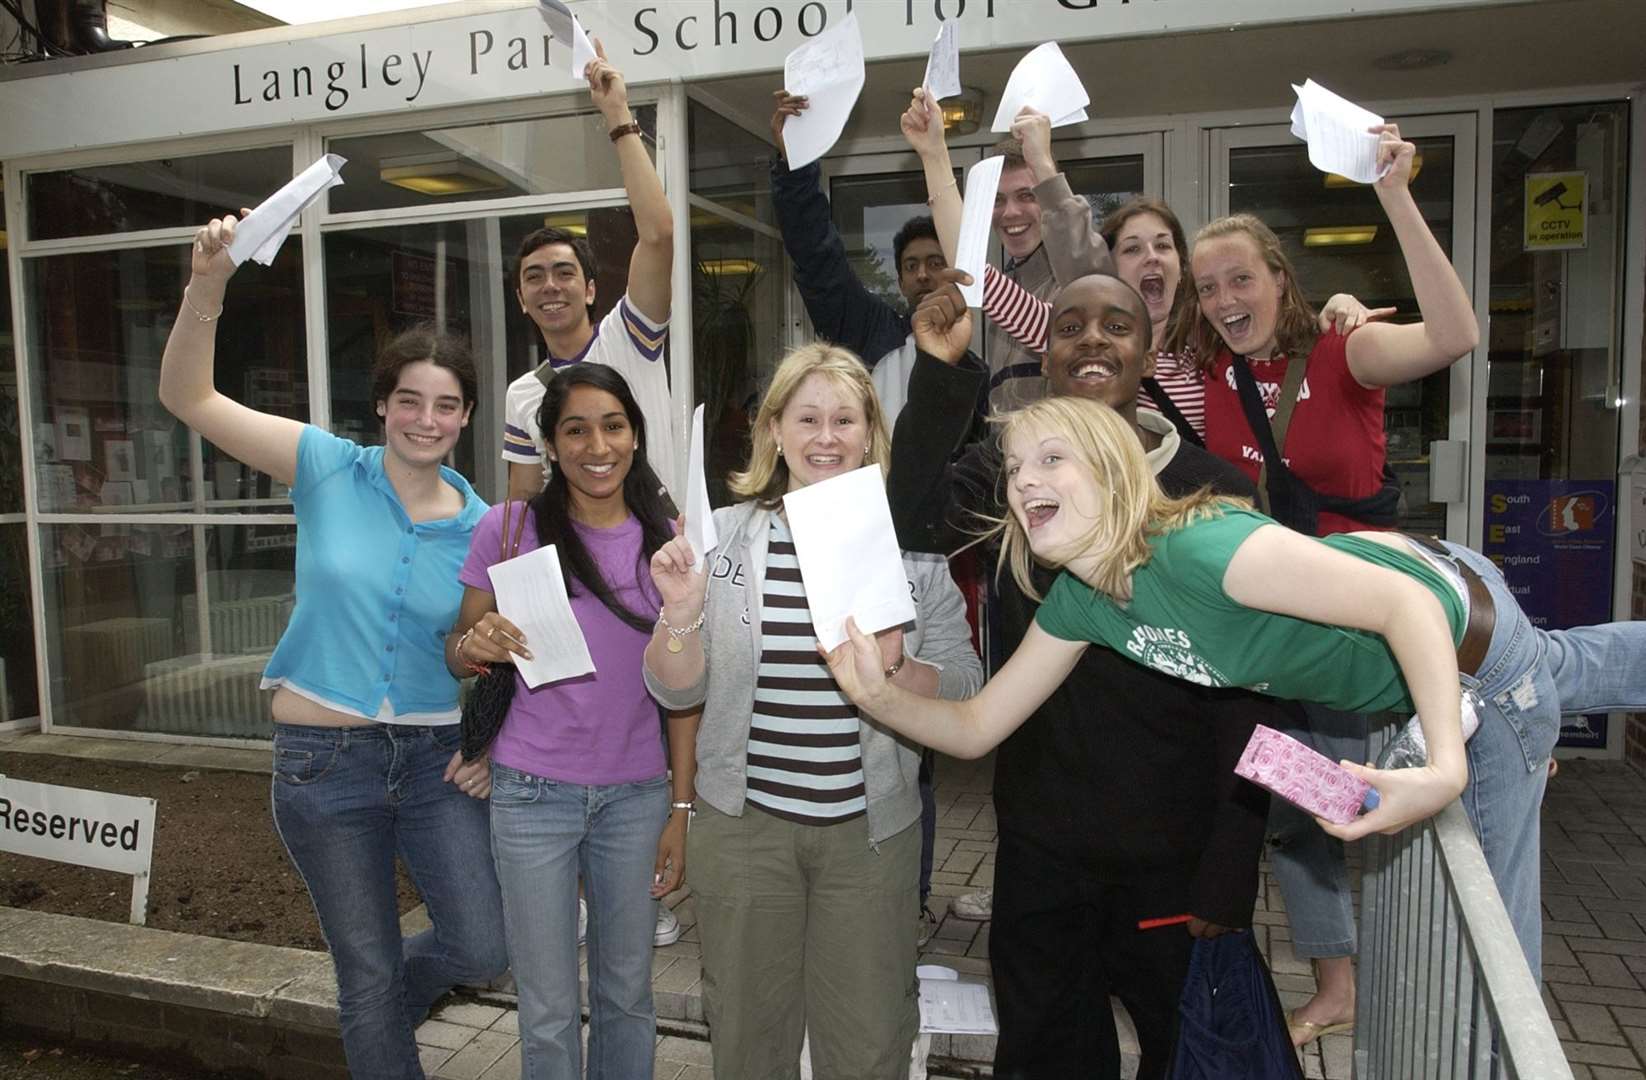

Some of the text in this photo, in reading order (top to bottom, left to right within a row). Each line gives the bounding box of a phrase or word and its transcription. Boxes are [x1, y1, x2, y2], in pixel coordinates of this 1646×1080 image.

[233, 43, 433, 111] Langley
[469, 14, 590, 75] Par
[1542, 220, 1570, 230] CCTV
[1539, 231, 1583, 241] operation
[1491, 494, 1530, 513] South
[1488, 524, 1521, 544] East
[0, 797, 139, 851] Reserved
